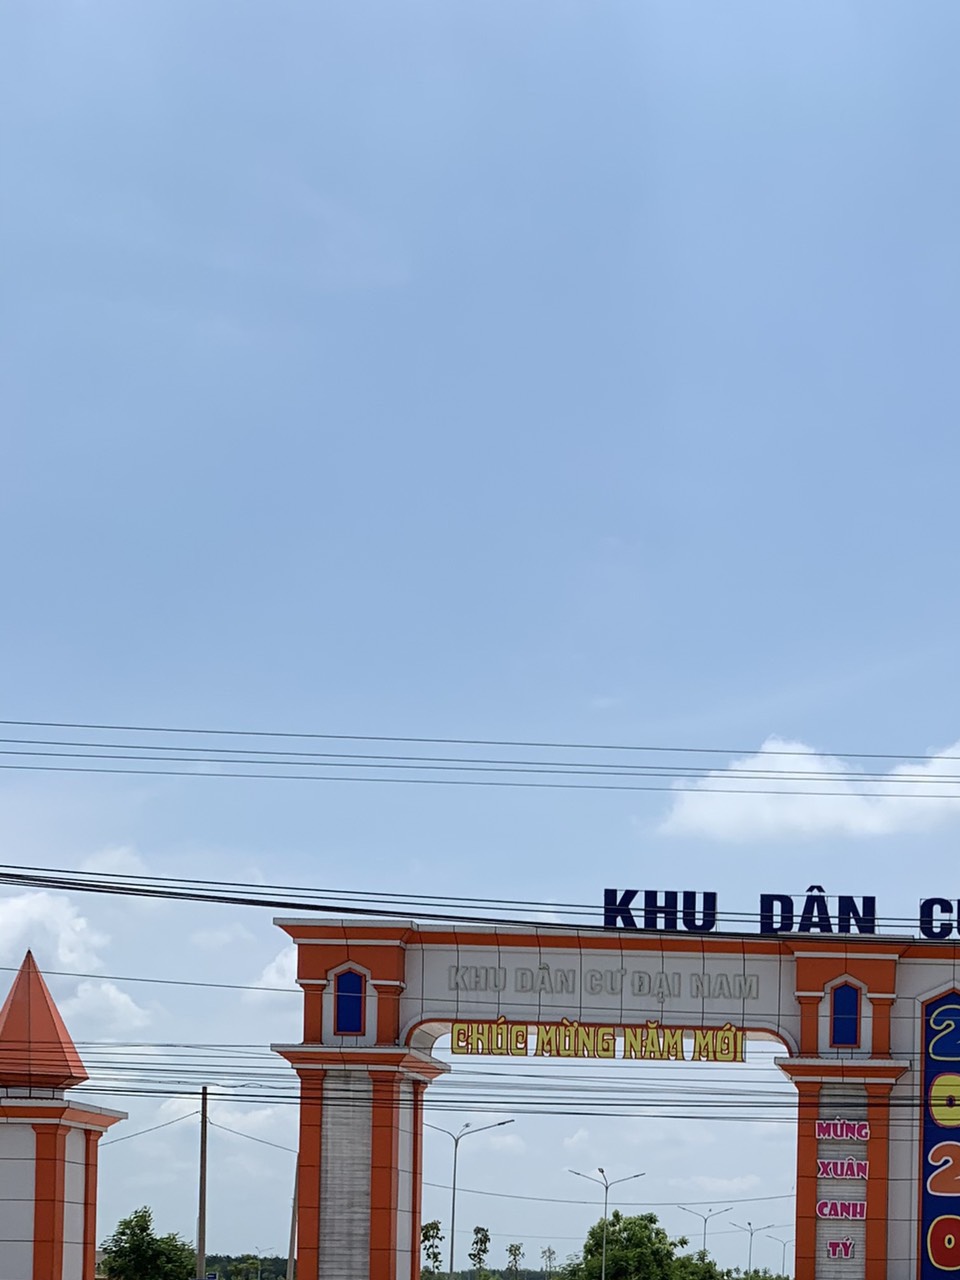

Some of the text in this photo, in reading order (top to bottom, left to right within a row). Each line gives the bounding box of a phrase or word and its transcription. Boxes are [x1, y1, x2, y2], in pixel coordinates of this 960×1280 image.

[604, 889, 717, 931] KHU
[760, 885, 876, 934] DÂN
[447, 966, 507, 992] KHU
[515, 962, 576, 994] DÂN
[584, 968, 627, 995] CƯ
[689, 973, 759, 1000] NAM
[451, 1015, 746, 1063] CHÚC MỪNG NĂM MỚI
[816, 1116, 870, 1141] MỪNG
[817, 1156, 869, 1180] XUÂN
[816, 1200, 867, 1219] CANH
[827, 1236, 854, 1258] TÝ
